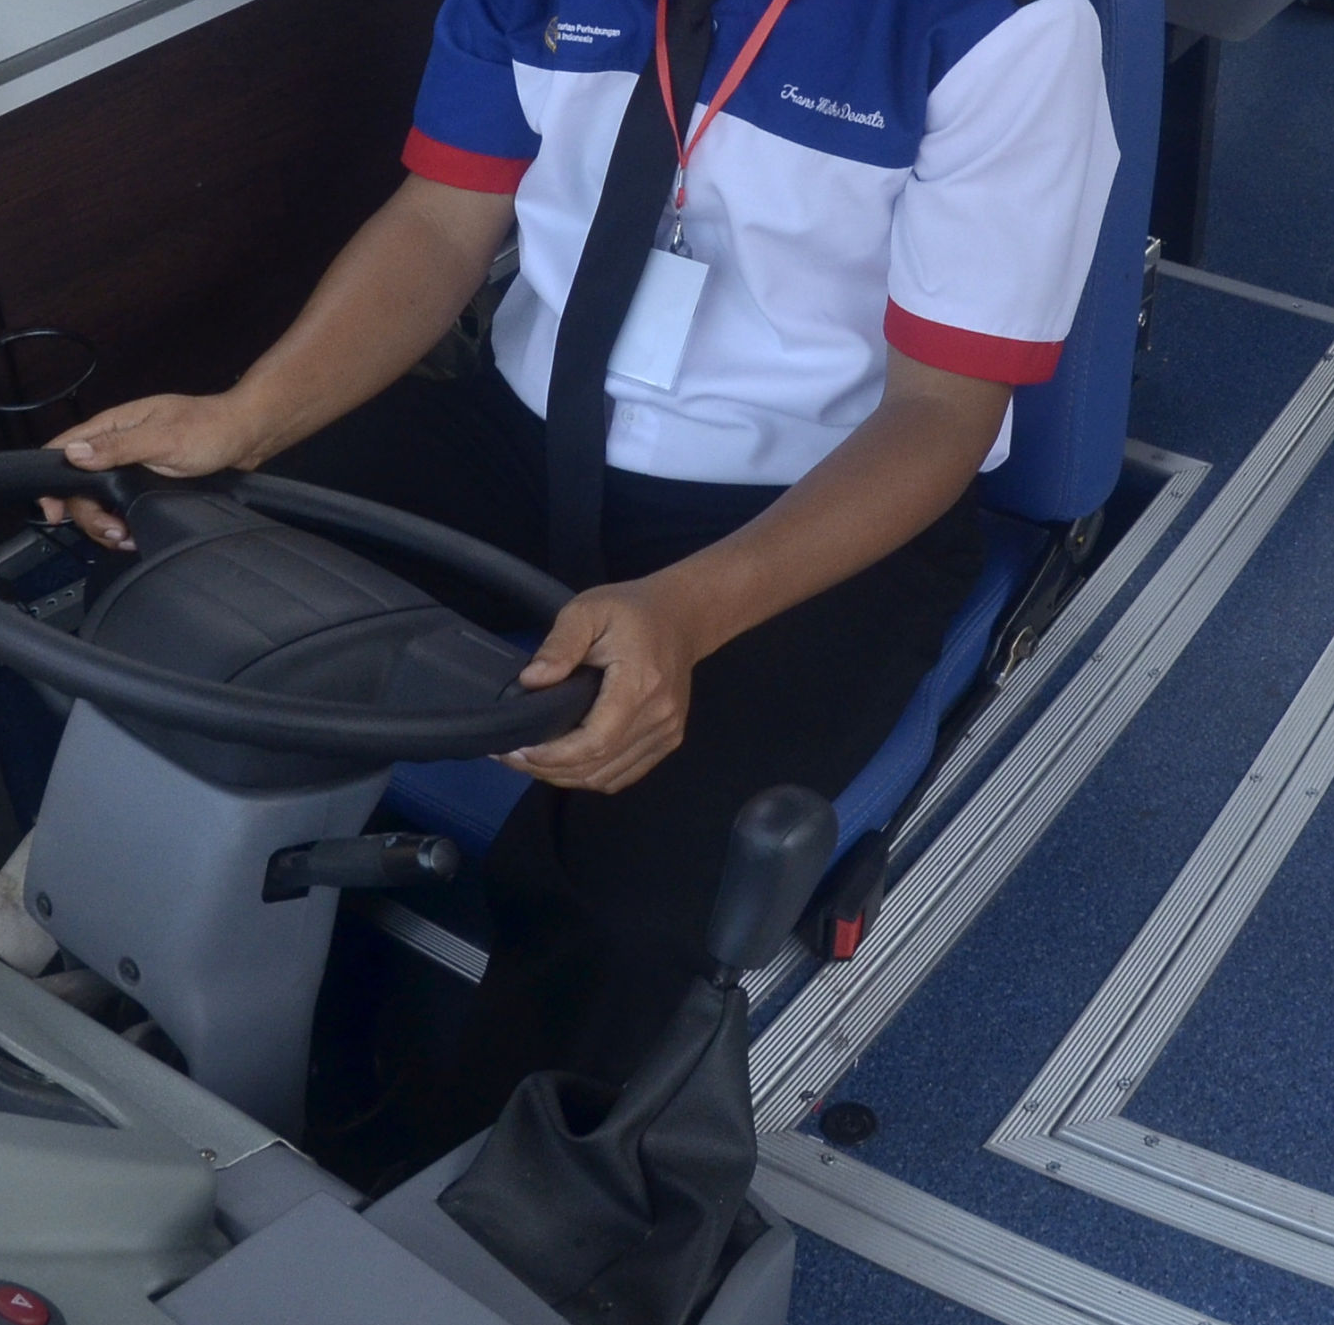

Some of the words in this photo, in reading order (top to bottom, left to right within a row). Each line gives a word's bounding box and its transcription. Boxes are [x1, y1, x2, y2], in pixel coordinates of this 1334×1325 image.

[576, 24, 621, 38] Perhubungan
[781, 83, 815, 109] Trans
[839, 103, 885, 129] Dewata
